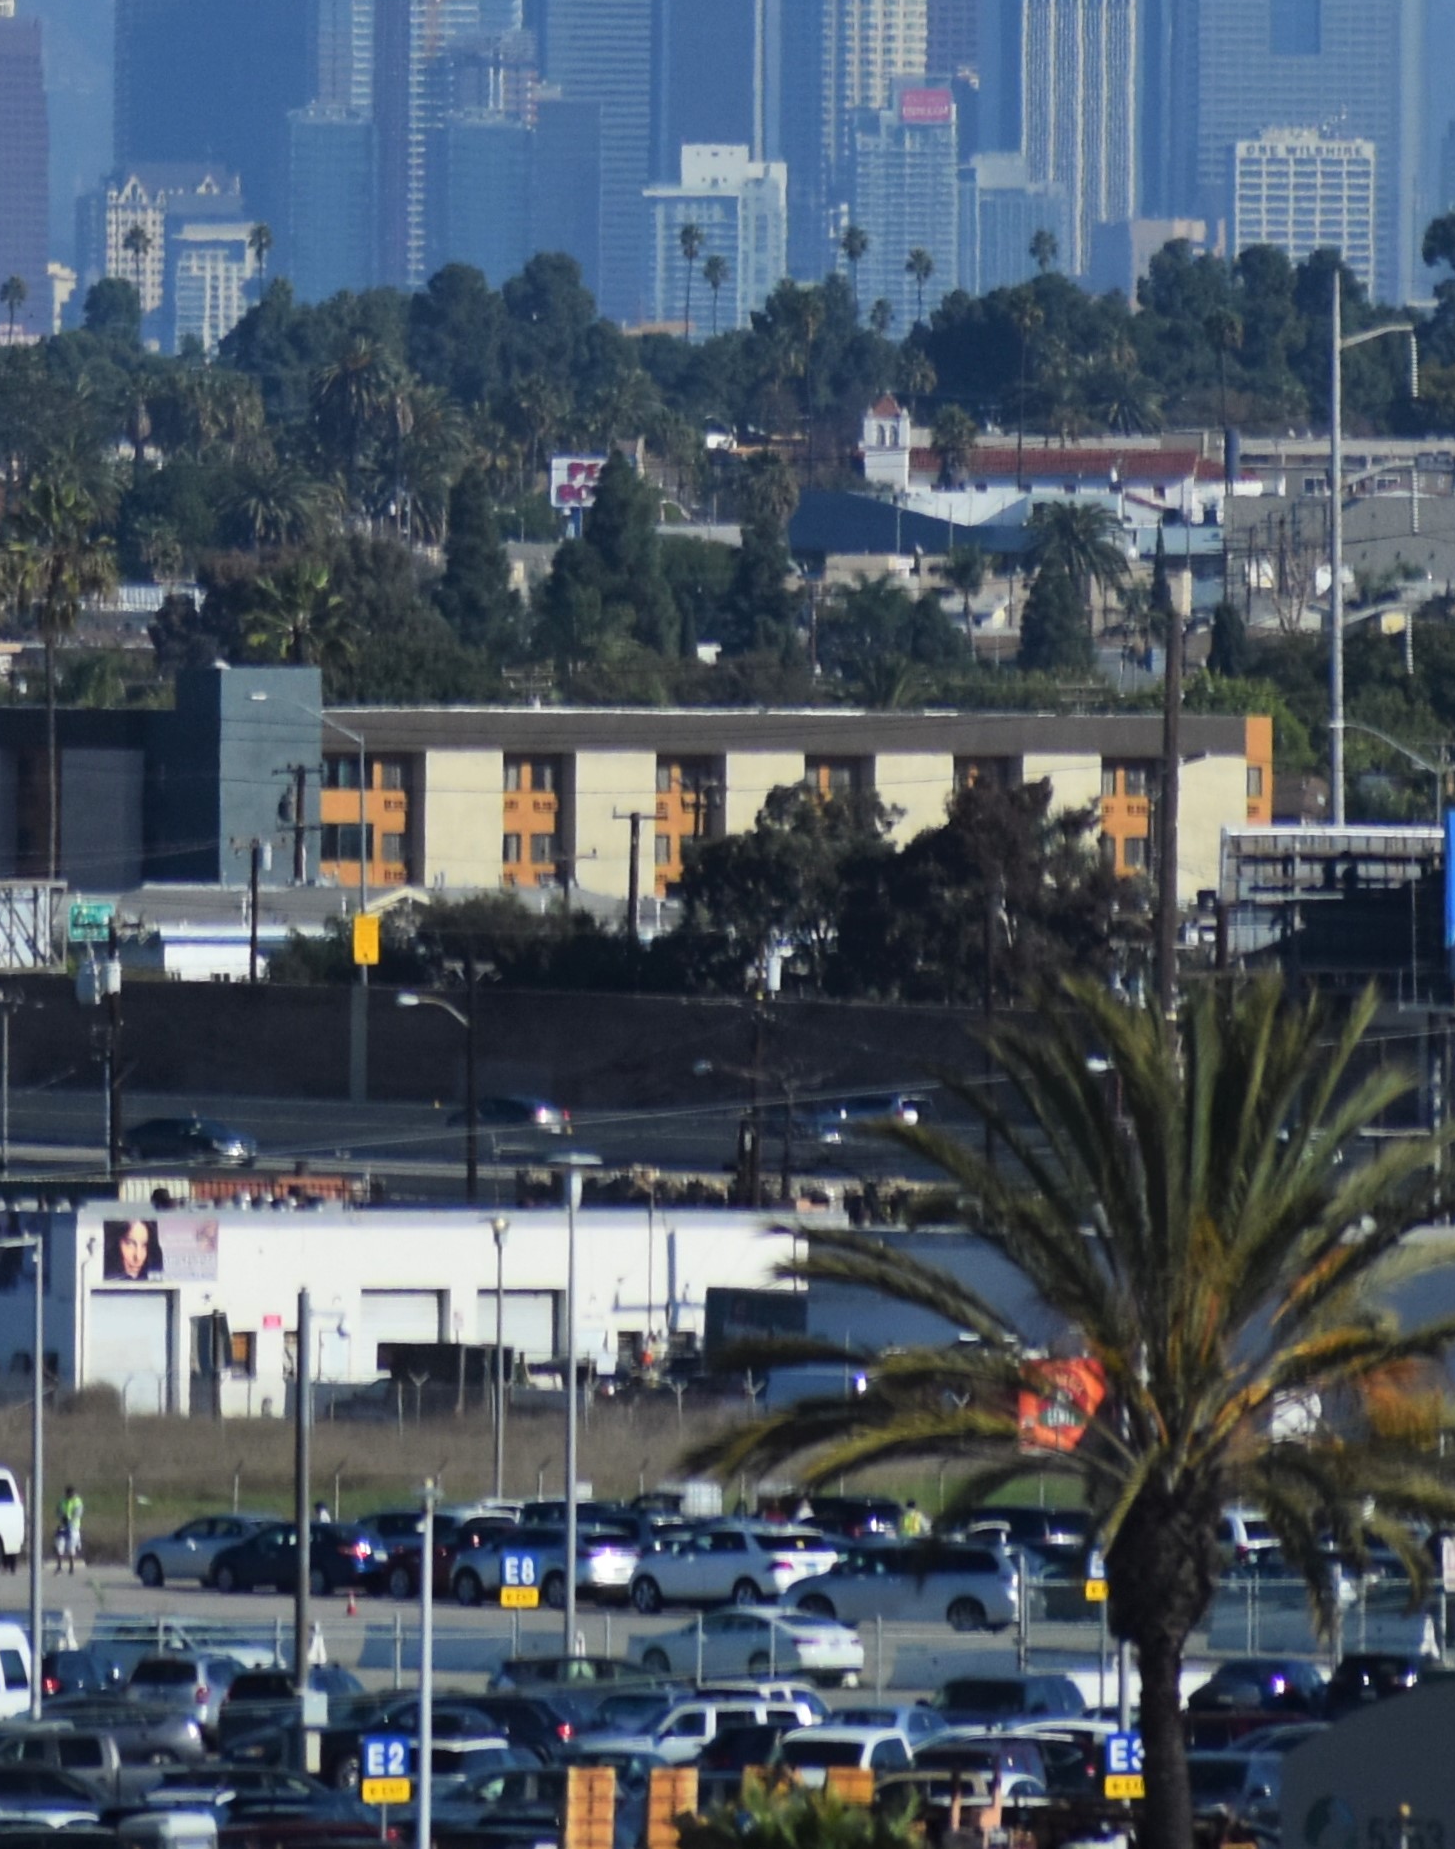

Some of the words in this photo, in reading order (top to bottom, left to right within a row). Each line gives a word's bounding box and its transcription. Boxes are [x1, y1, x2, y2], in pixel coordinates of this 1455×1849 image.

[1246, 145, 1278, 157] ONE
[1285, 145, 1363, 157] WILSHIRE
[504, 1556, 535, 1586] E8
[367, 1742, 405, 1775] E2
